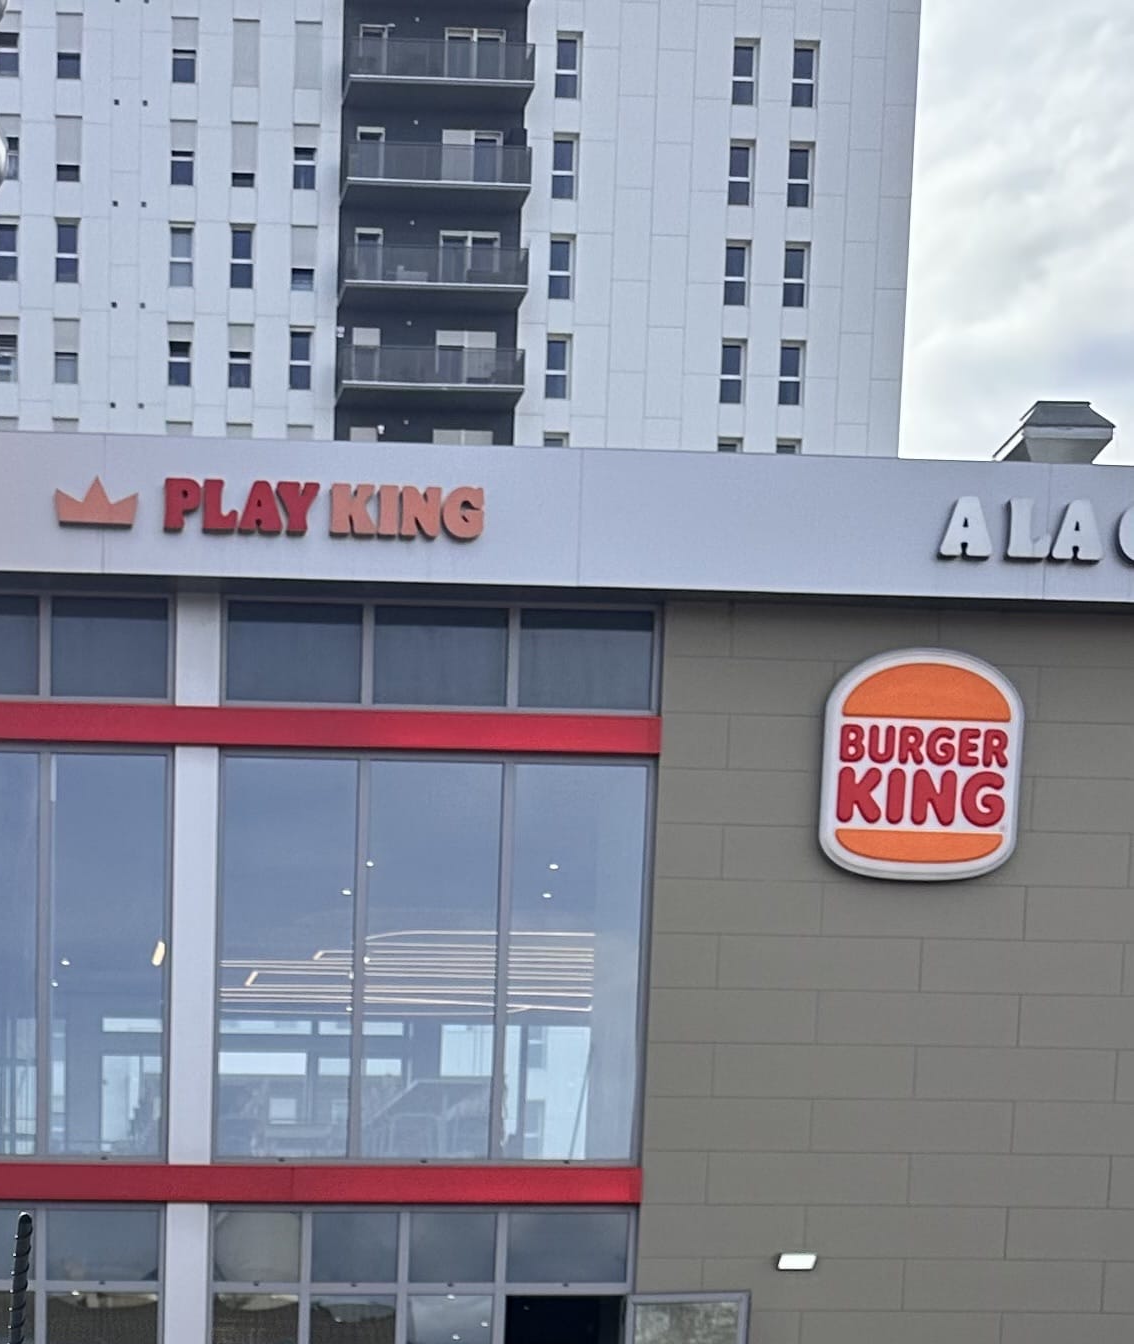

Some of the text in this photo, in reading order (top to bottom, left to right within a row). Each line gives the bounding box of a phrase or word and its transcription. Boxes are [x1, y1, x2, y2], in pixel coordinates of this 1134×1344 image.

[163, 476, 485, 542] PLAY KING
[839, 723, 1009, 768] BURGER
[835, 766, 1006, 828] KING
